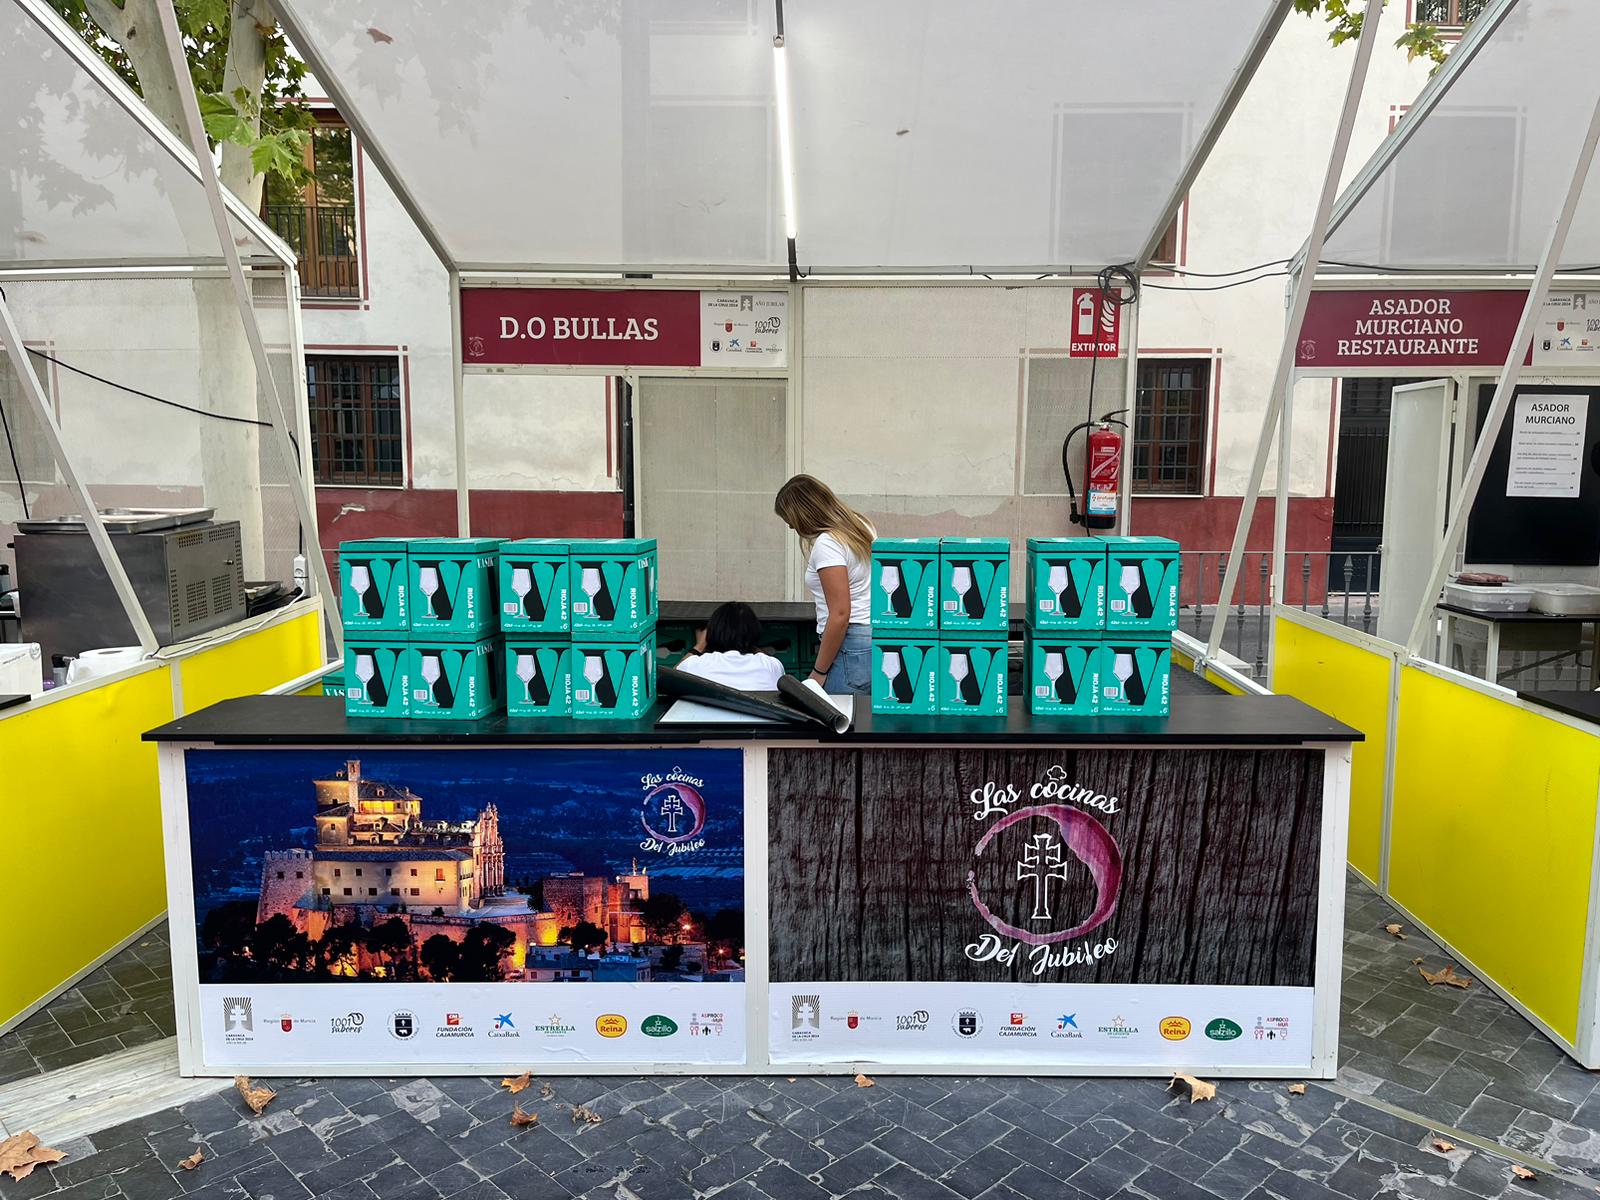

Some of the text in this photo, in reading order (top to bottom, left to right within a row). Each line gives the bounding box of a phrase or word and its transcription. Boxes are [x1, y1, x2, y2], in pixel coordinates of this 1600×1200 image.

[1369, 299, 1451, 316] ASADOR
[500, 316, 659, 340] D.O BULLAS
[1354, 318, 1463, 336] MURCIANO
[1071, 343, 1116, 351] EXTINTOR
[1337, 338, 1478, 356] RESTAURANTE
[1531, 403, 1570, 412] ASADOR
[1525, 416, 1576, 424] MURCIANO
[399, 608, 406, 617] 42
[468, 610, 475, 619] 42
[561, 611, 567, 620] 42
[631, 610, 637, 618] 42
[927, 608, 934, 617] 42
[1000, 608, 1007, 617] 42
[1097, 607, 1103, 616] 42
[1169, 608, 1176, 617] 42
[402, 697, 409, 706] 42
[565, 695, 572, 704] 42
[632, 697, 639, 706] 42
[929, 693, 935, 702] 42
[997, 695, 1003, 704] 42
[1092, 695, 1099, 704] 42
[1161, 696, 1168, 705] 42
[469, 698, 476, 707] 42
[641, 773, 704, 790] Las cocinas
[970, 780, 1121, 820] Las cocinas
[640, 837, 705, 856] Del Jubileo
[964, 933, 1118, 976] Del Jubileo
[331, 1018, 351, 1026] 1001
[896, 1016, 916, 1024] 1001
[331, 1025, 363, 1033] sabores
[896, 1023, 927, 1031] sabores
